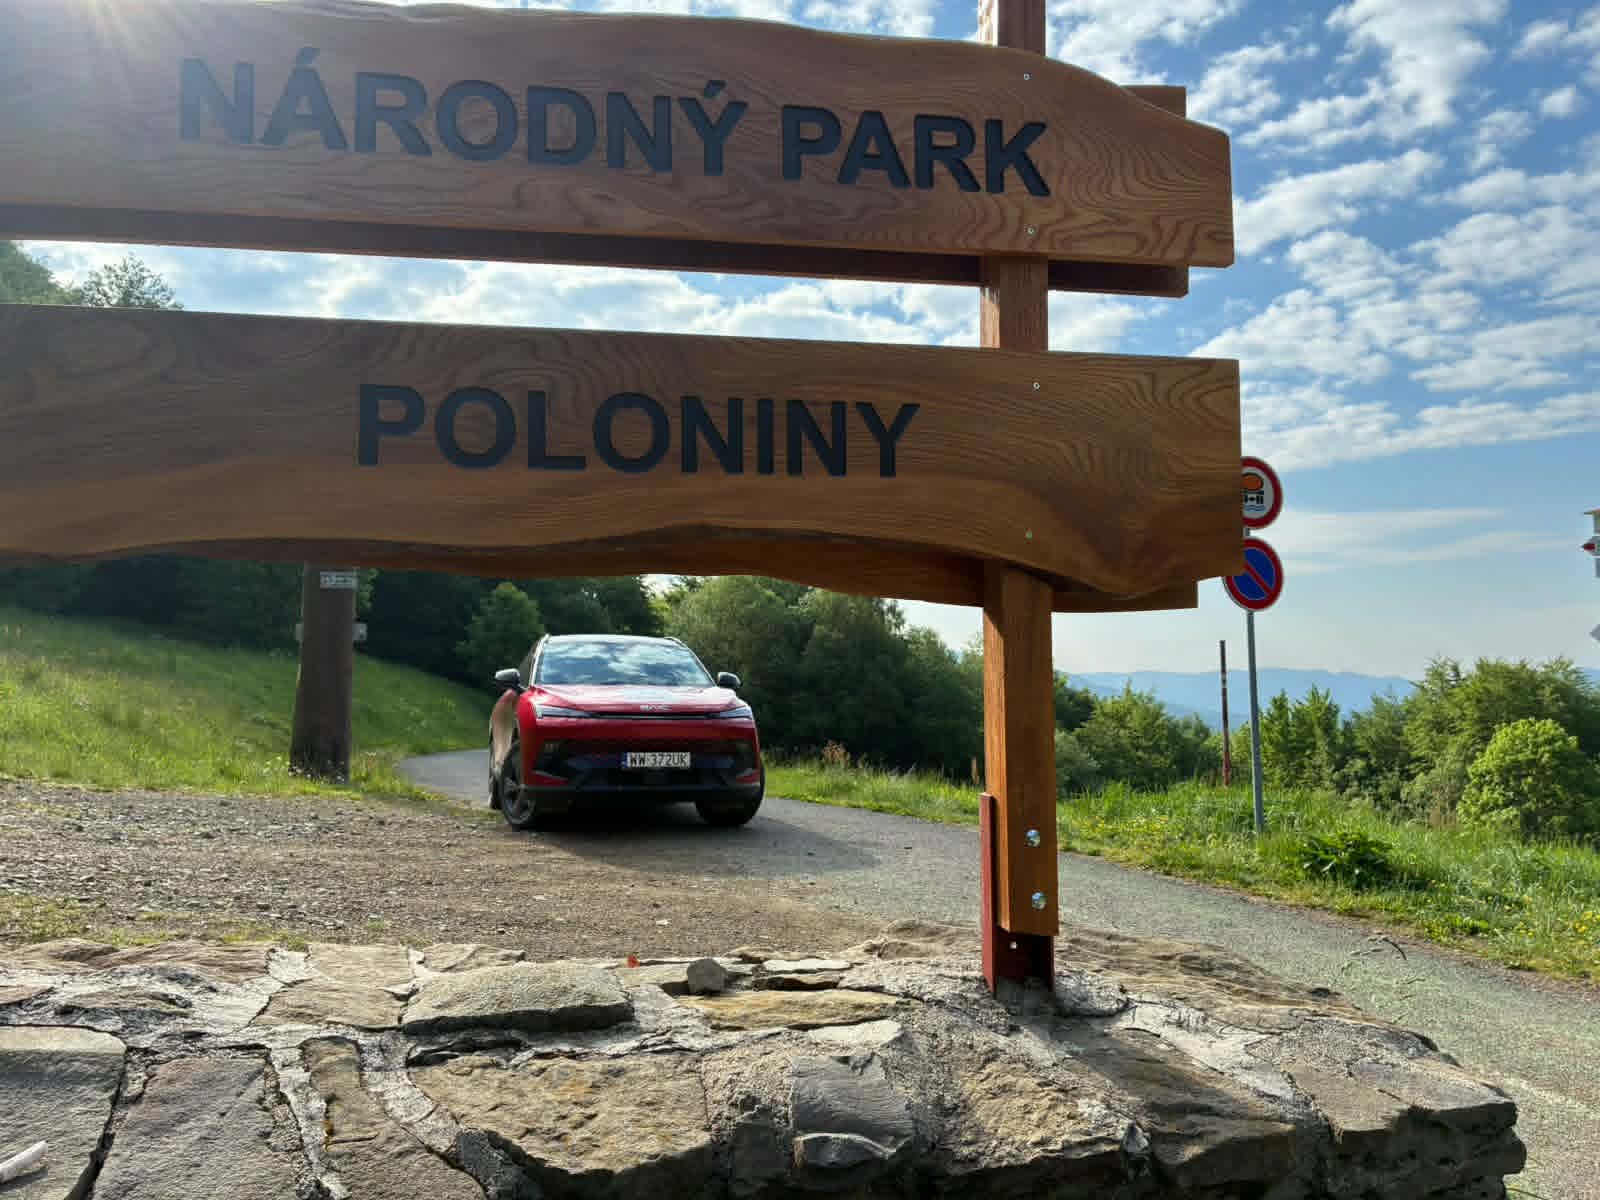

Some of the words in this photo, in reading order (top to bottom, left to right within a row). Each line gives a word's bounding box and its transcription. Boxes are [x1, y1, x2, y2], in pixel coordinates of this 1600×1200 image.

[179, 46, 748, 176] NÁRODNÝ
[781, 104, 1050, 197] PARK
[357, 383, 921, 477] POLONINY
